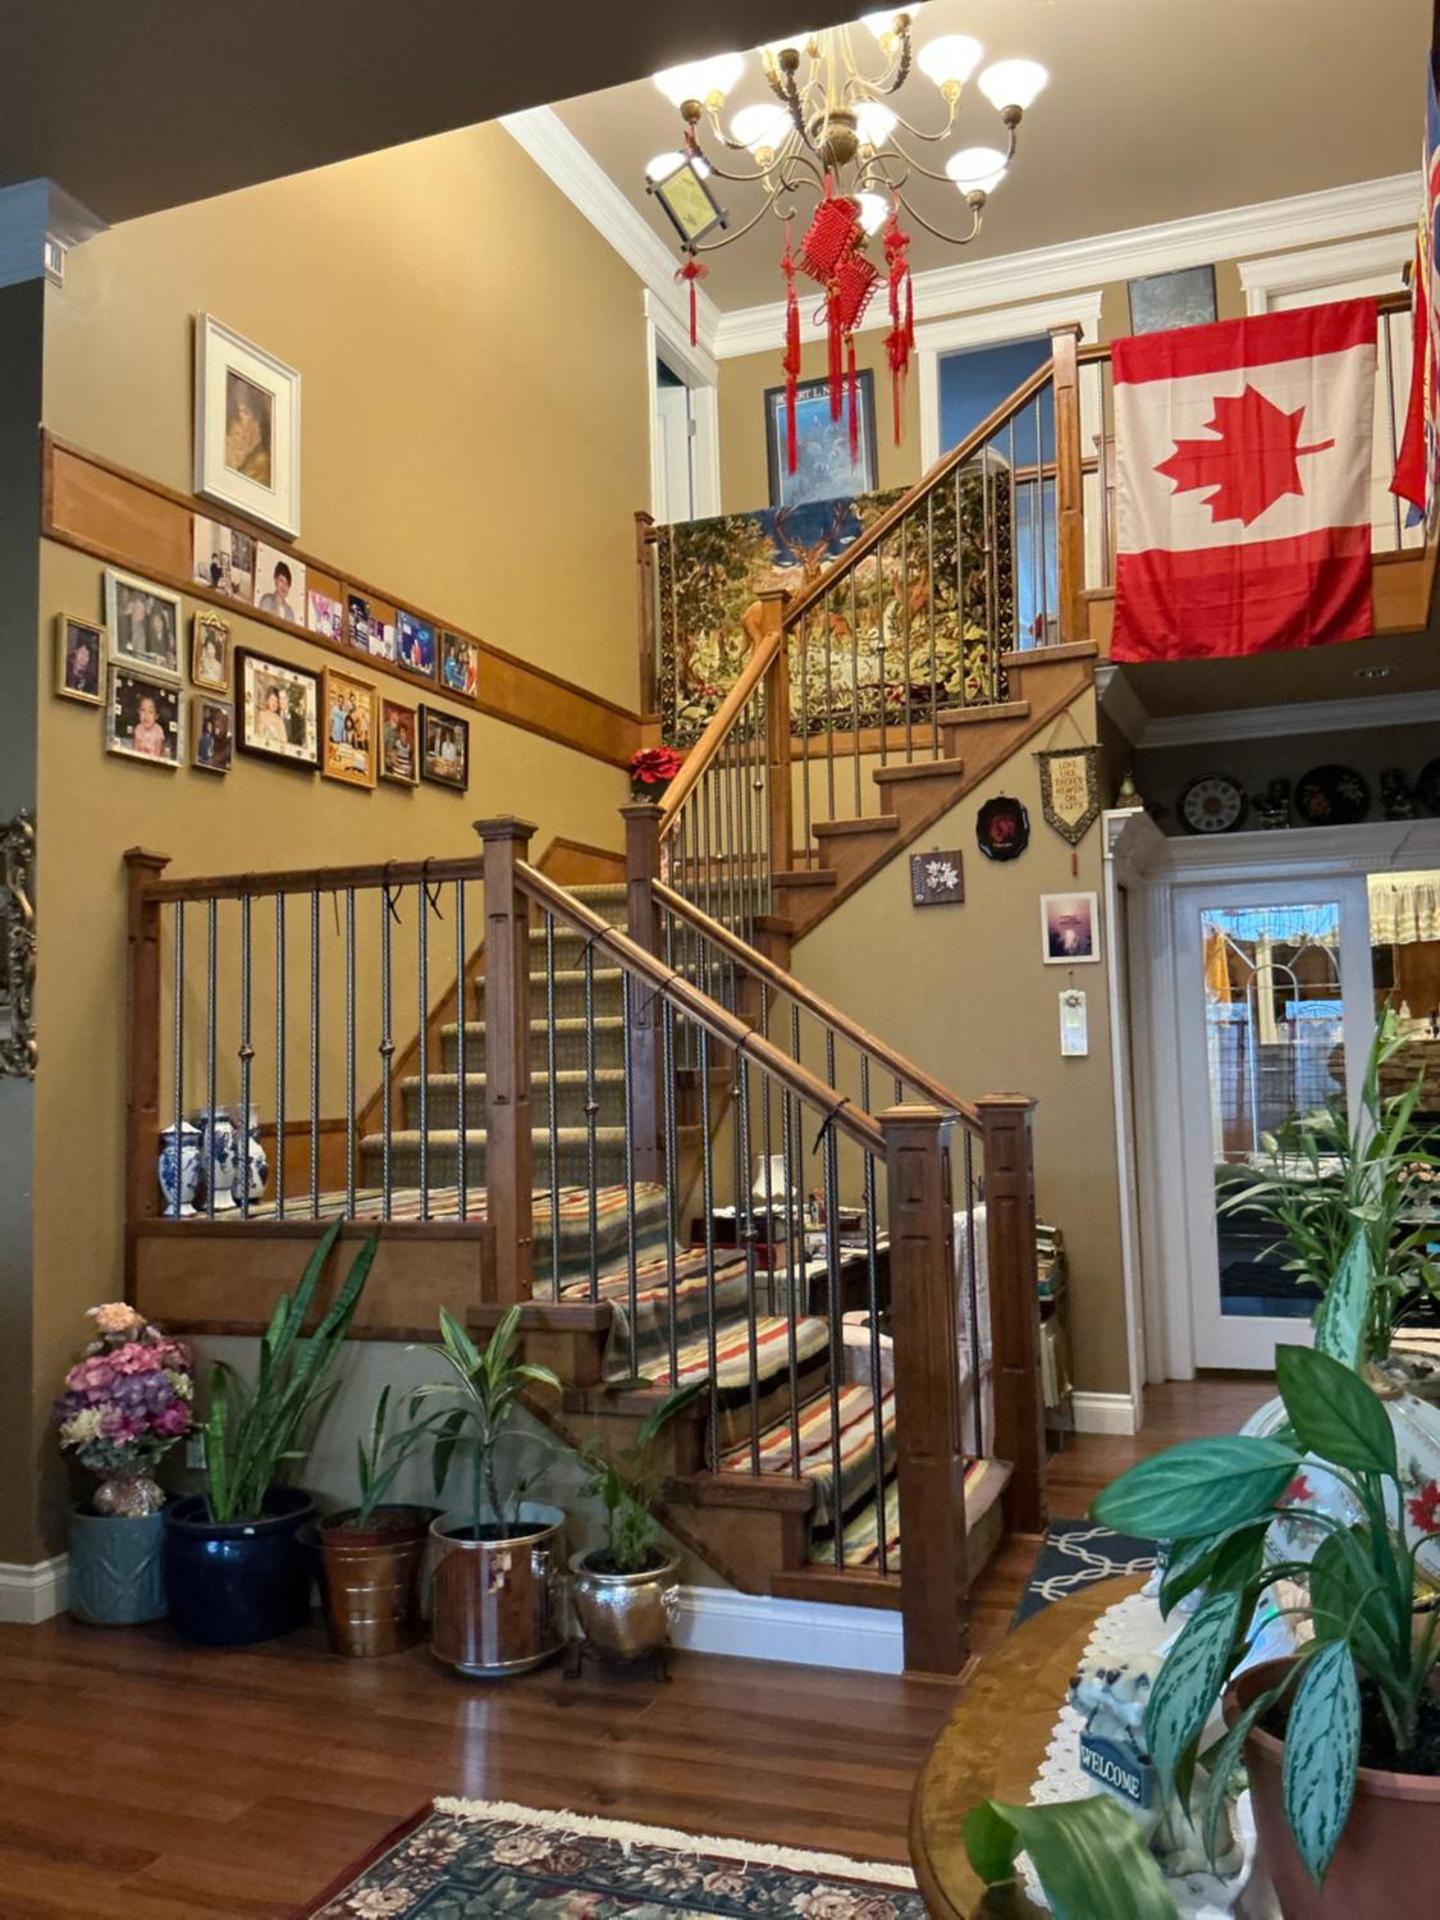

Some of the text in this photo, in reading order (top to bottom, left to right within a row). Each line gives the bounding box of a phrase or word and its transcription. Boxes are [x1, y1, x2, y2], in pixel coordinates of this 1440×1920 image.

[1058, 760, 1076, 769] LOVE
[1060, 769, 1075, 777] LIKE
[1080, 1746, 1140, 1799] WELCOME
